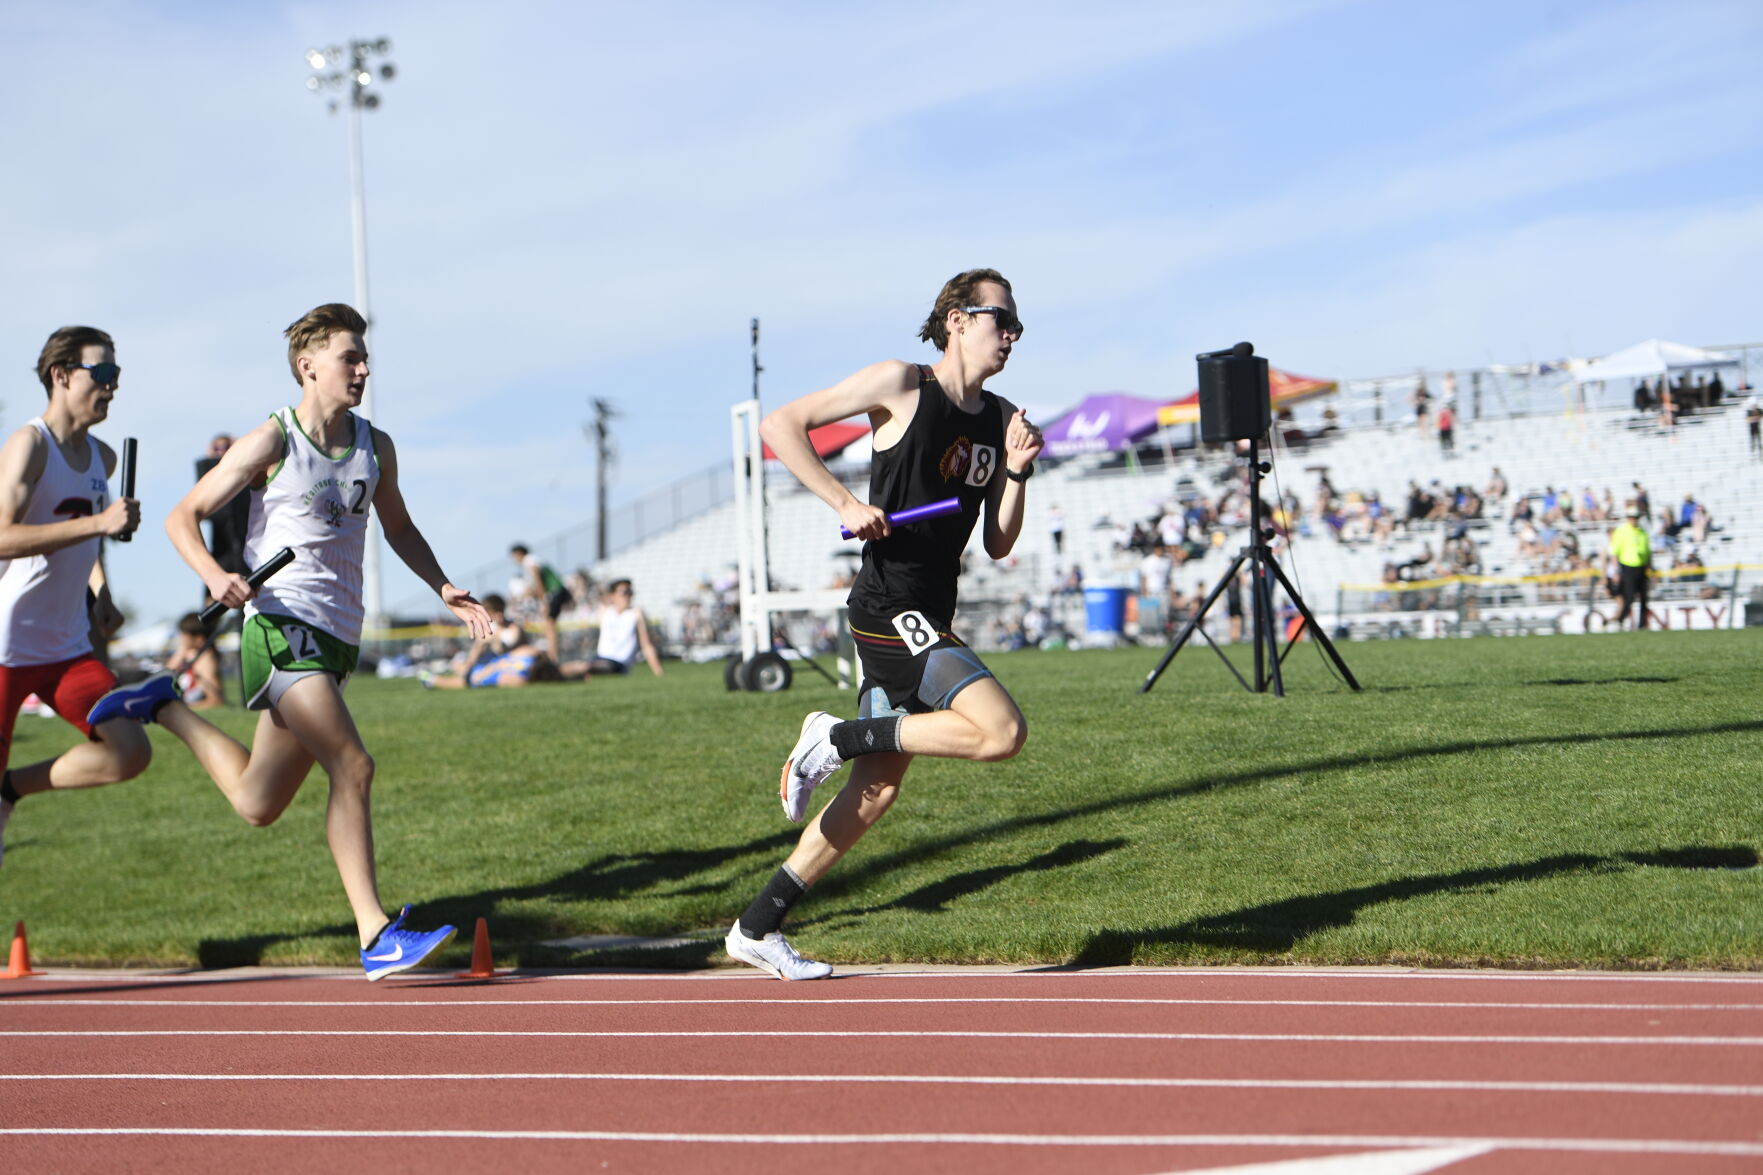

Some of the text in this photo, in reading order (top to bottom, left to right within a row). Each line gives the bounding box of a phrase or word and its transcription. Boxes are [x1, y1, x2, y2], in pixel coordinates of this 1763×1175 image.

[973, 447, 992, 485] 8
[351, 479, 367, 515] 2
[290, 625, 316, 658] 2
[901, 613, 930, 647] 8
